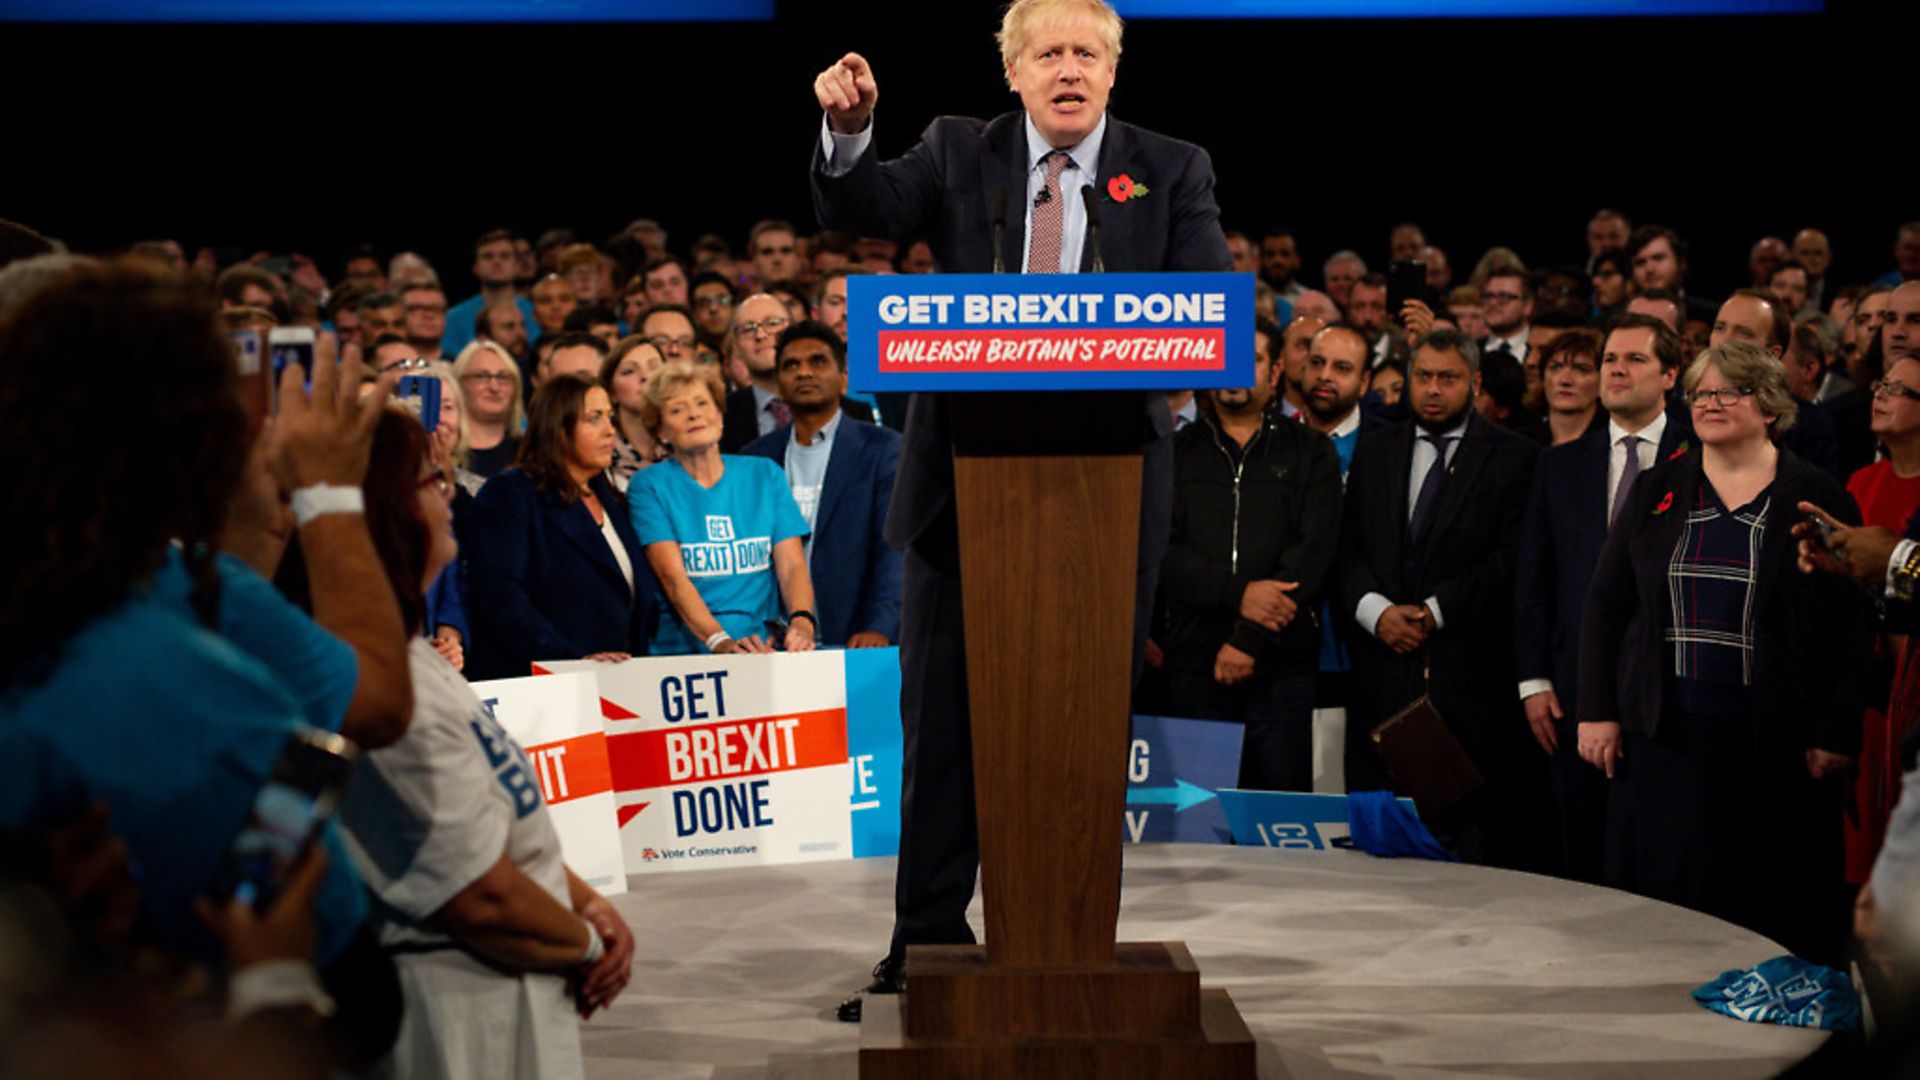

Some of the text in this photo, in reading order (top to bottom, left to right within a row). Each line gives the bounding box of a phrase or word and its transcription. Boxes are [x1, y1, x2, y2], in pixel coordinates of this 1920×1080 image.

[879, 293, 1225, 324] GET BREXIT DONE
[885, 336, 1217, 363] UNLEASH BRITAIN'S POTENTIAL
[710, 519, 730, 538] GET
[660, 670, 729, 722] GET
[665, 718, 799, 781] BREXIT
[673, 780, 774, 837] DONE
[661, 843, 758, 860] Vote Conservative
